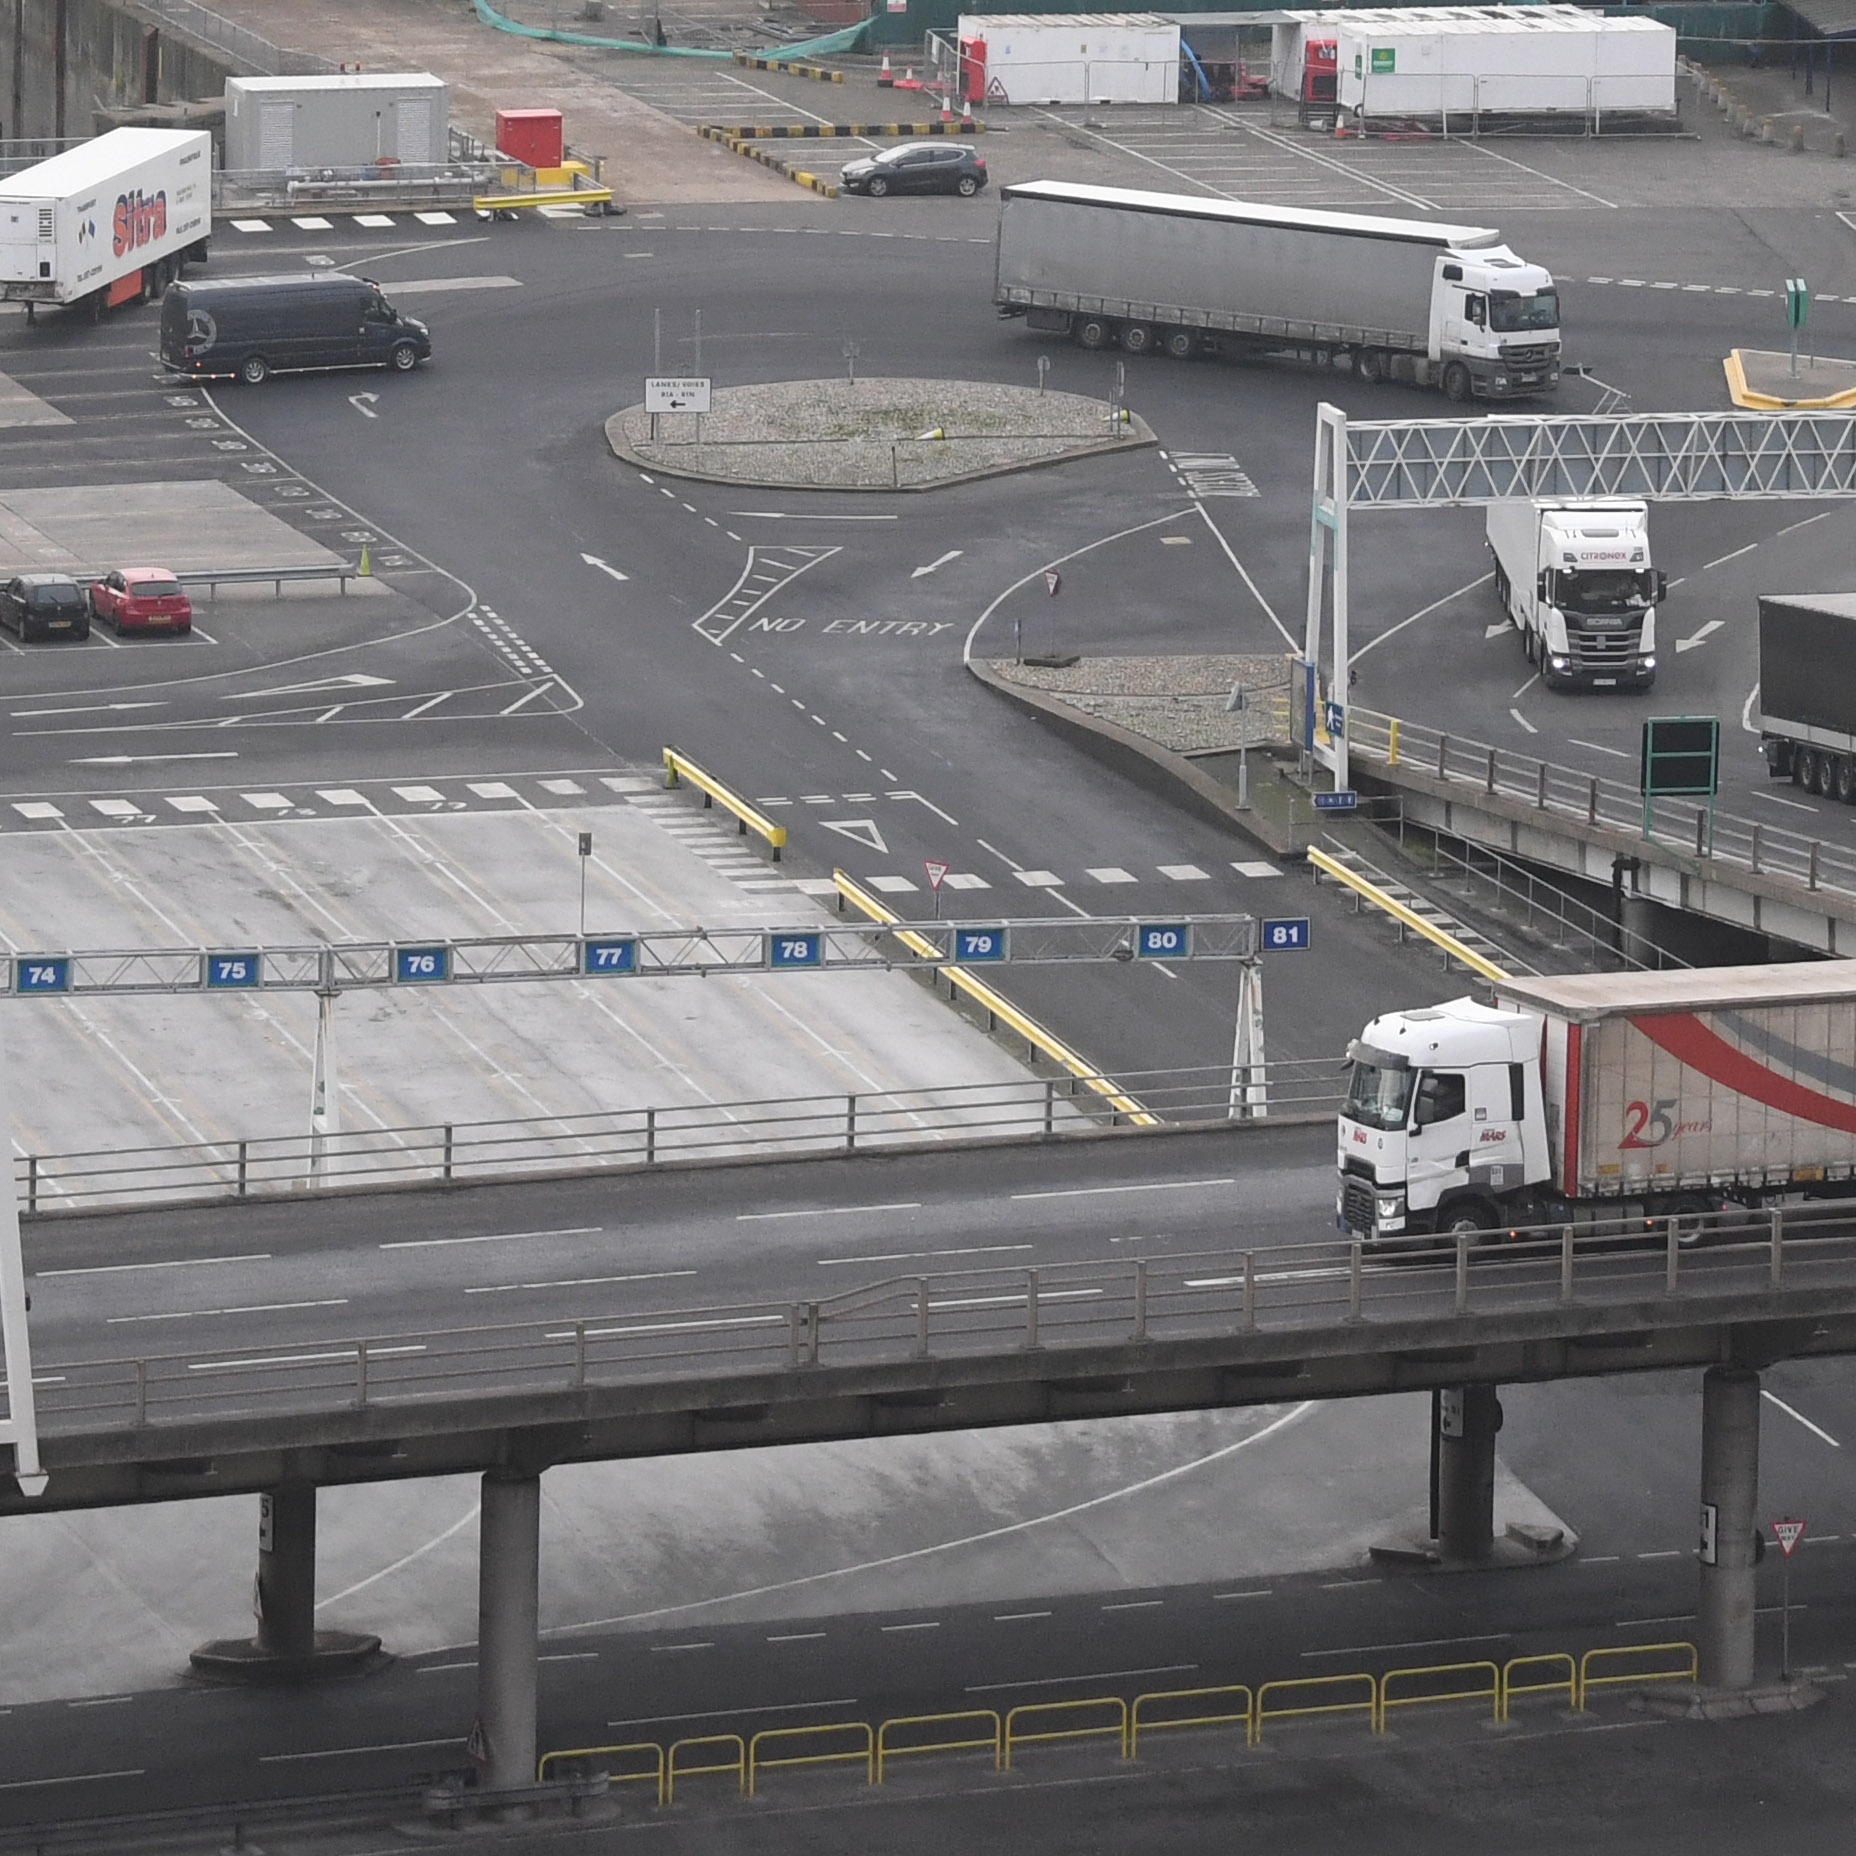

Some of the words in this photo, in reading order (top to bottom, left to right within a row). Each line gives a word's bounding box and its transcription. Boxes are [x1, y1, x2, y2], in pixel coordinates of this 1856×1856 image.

[112, 188, 167, 258] Sitra
[1148, 932, 1177, 949] 80
[1273, 927, 1298, 944] 81
[781, 942, 808, 958] 78
[965, 936, 992, 953] 79
[408, 956, 435, 973] 76
[596, 948, 623, 965] 77
[29, 967, 55, 984] 74
[219, 962, 246, 979] 75
[1617, 1098, 1677, 1149] 25
[1672, 1121, 1712, 1141] years
[1480, 1130, 1506, 1142] MARS
[1778, 1525, 1799, 1535] GIVE
